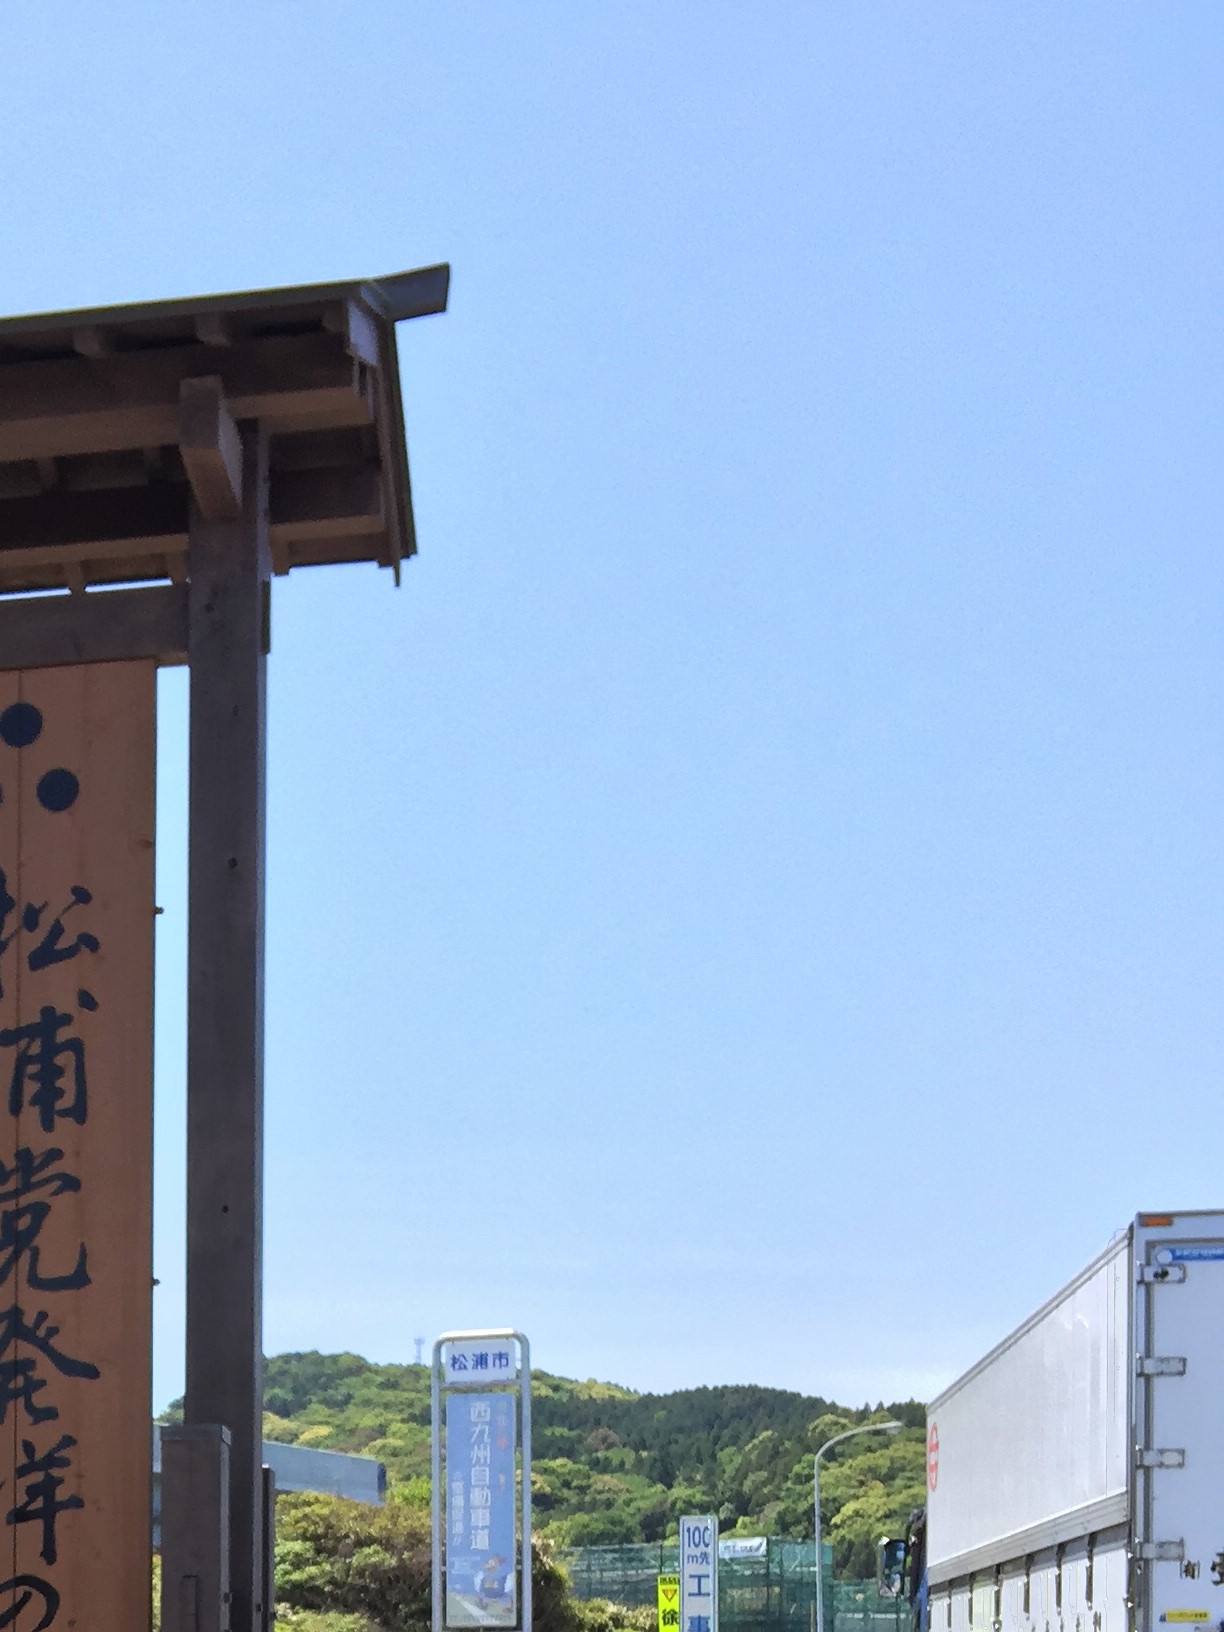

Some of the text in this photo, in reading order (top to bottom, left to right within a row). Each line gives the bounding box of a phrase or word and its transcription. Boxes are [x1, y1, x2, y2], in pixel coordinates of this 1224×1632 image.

[450, 1352, 510, 1372] 松浦市
[470, 1402, 491, 1550] 西九州自動車道
